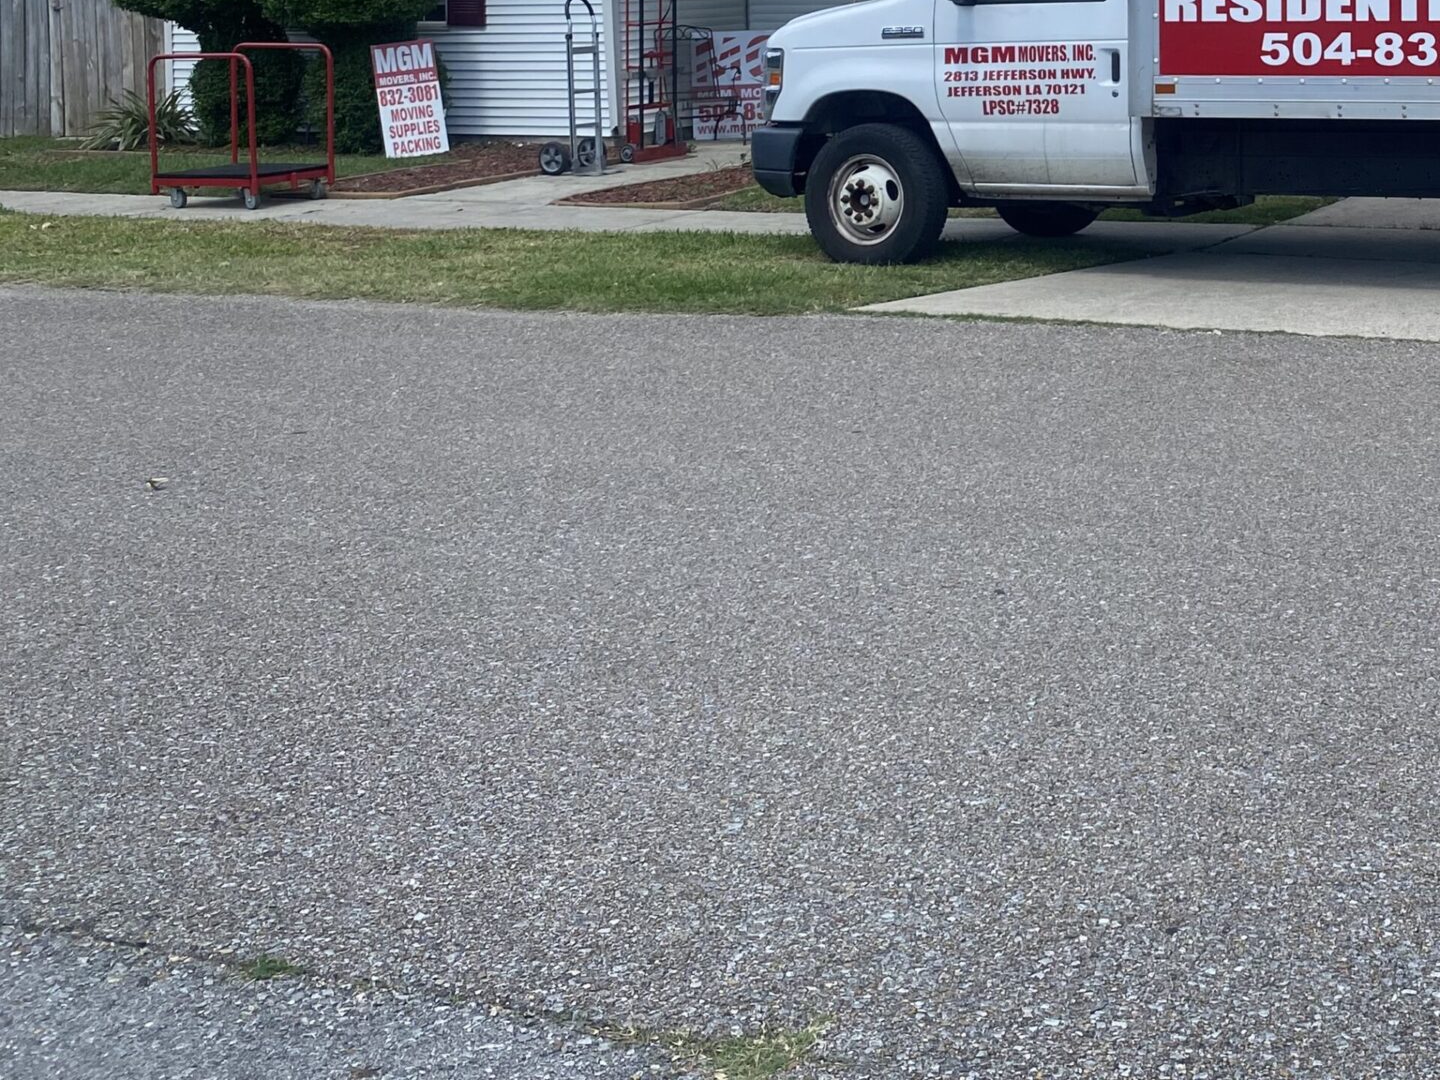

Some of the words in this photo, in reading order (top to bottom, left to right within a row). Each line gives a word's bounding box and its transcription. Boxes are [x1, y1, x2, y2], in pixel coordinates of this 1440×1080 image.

[373, 43, 434, 74] MGM
[944, 46, 1016, 64] MGM
[1018, 44, 1070, 63] MOVERS,
[1073, 44, 1096, 61] INC.
[379, 73, 417, 86] MOVERS,
[419, 71, 437, 81] INC.
[944, 71, 978, 82] 2813
[982, 69, 1057, 81] JEFFERSON
[1061, 68, 1096, 80] HWY,
[379, 84, 438, 107] 832-3081
[947, 85, 1022, 97] JEFFERSON
[1026, 85, 1042, 95] LA
[1045, 84, 1085, 95] 70121
[391, 104, 434, 123] MOVING
[982, 99, 1059, 116] LPSC#7328
[389, 120, 440, 139] SUPPLIES
[393, 136, 441, 155] PACKING
